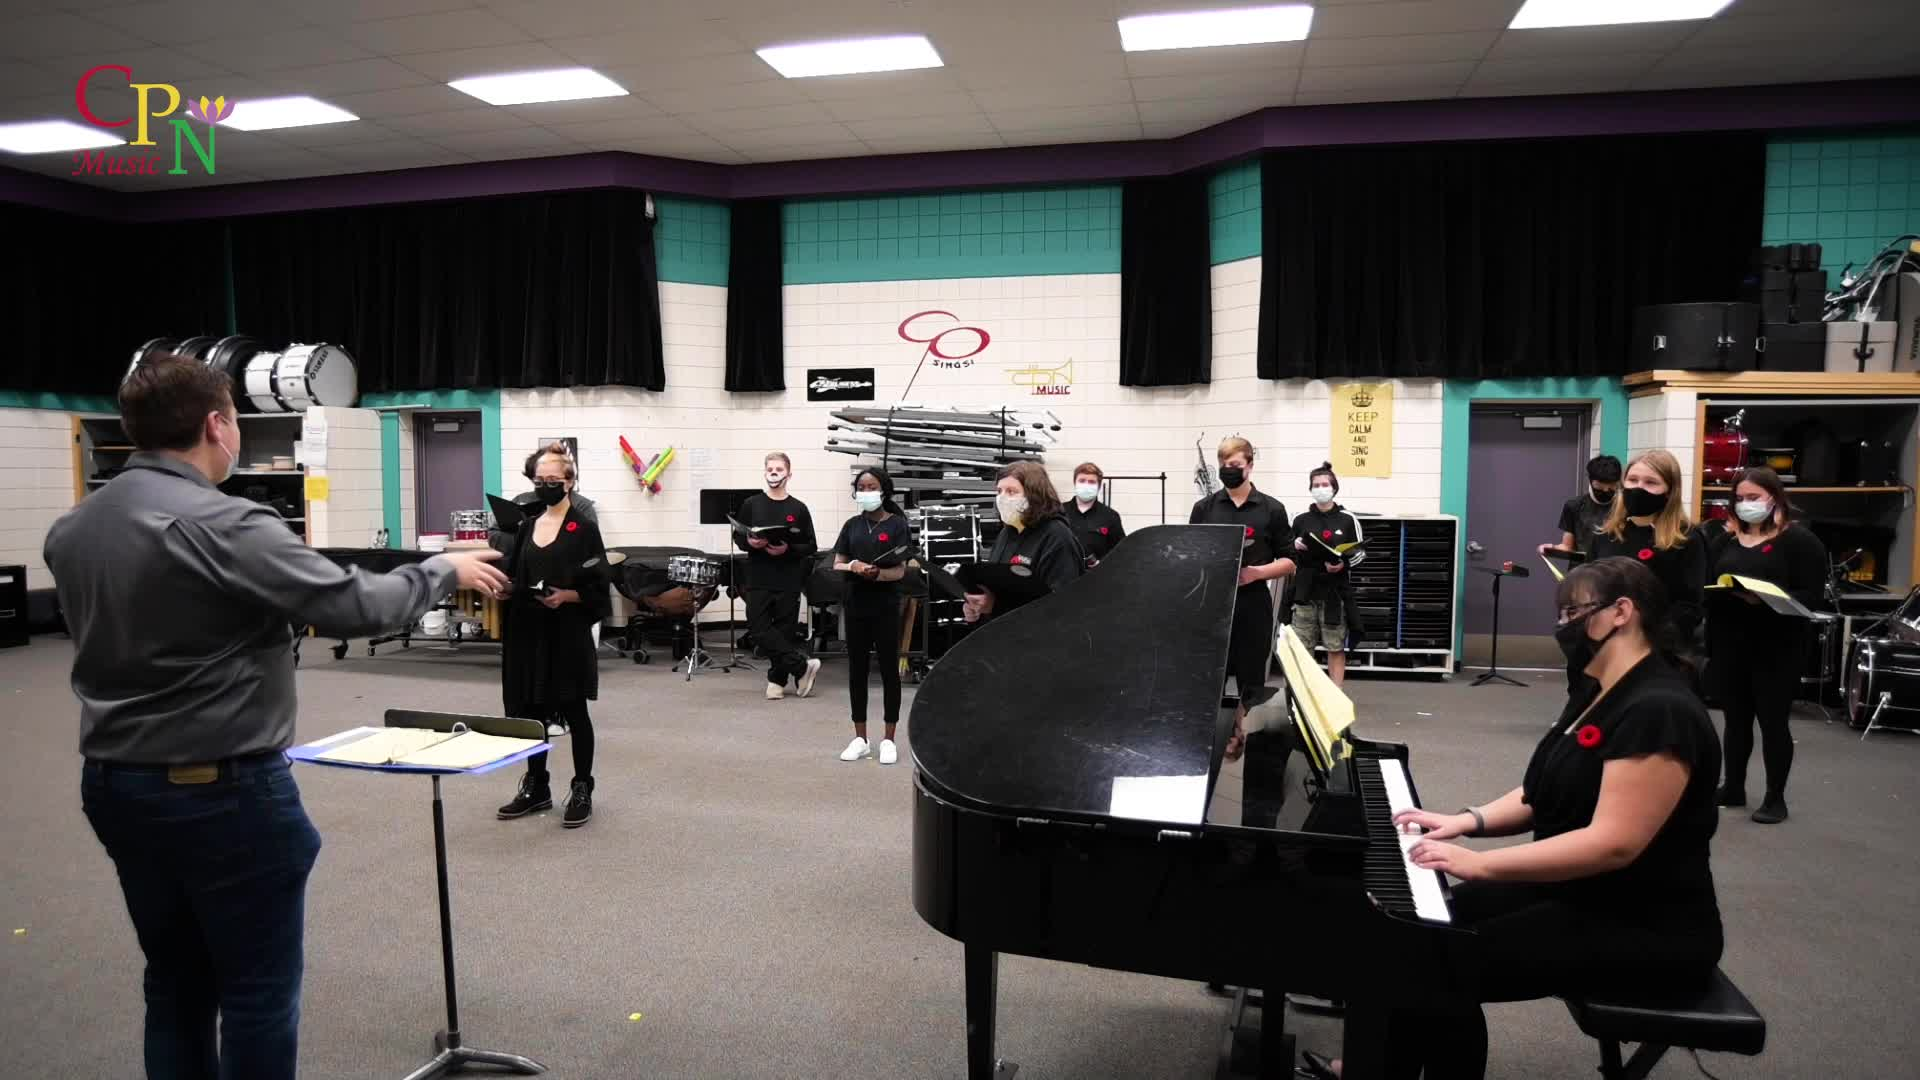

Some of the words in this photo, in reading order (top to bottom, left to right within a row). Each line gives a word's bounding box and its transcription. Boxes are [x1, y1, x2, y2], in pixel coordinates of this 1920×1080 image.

[1036, 385, 1071, 395] MUSIC
[1348, 412, 1378, 422] KEEP
[1349, 424, 1372, 434] CALM
[1351, 446, 1369, 456] SING
[1355, 458, 1366, 467] ON
